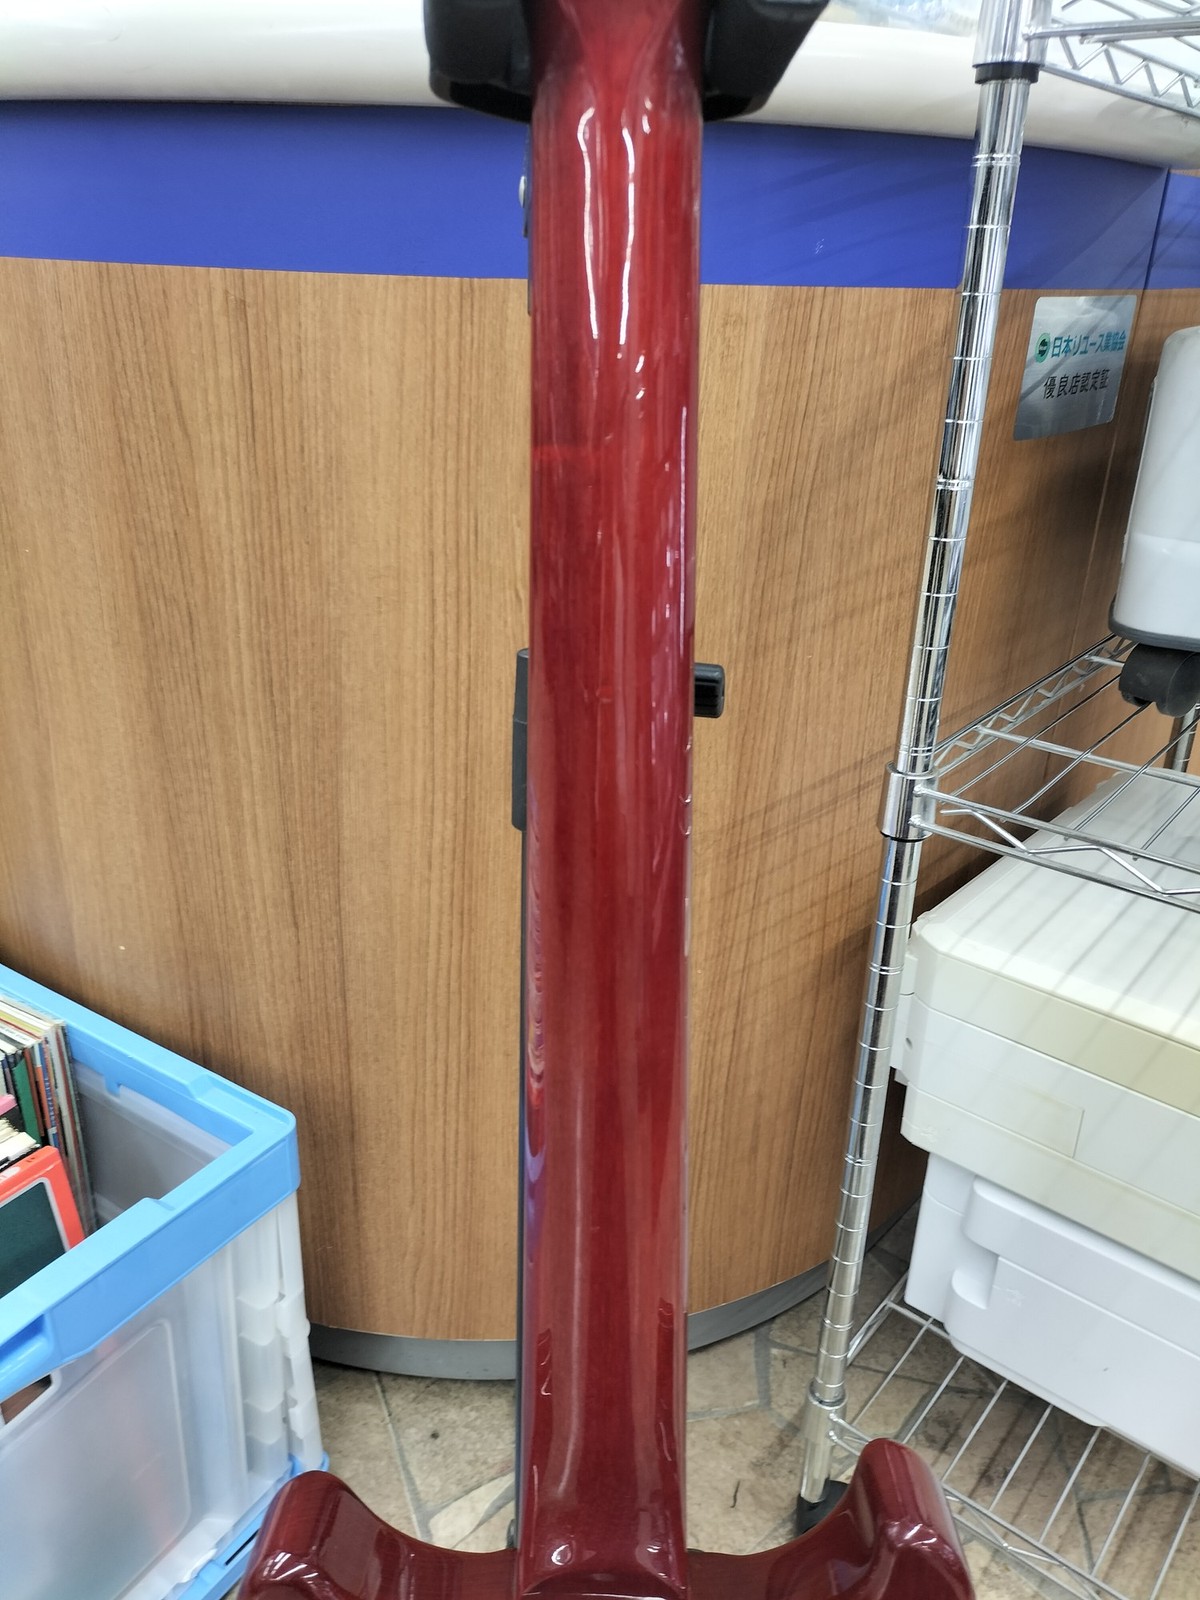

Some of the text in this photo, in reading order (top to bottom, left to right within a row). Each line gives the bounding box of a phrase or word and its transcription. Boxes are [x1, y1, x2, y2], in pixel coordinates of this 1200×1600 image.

[1043, 369, 1111, 399] 優良店認定証
